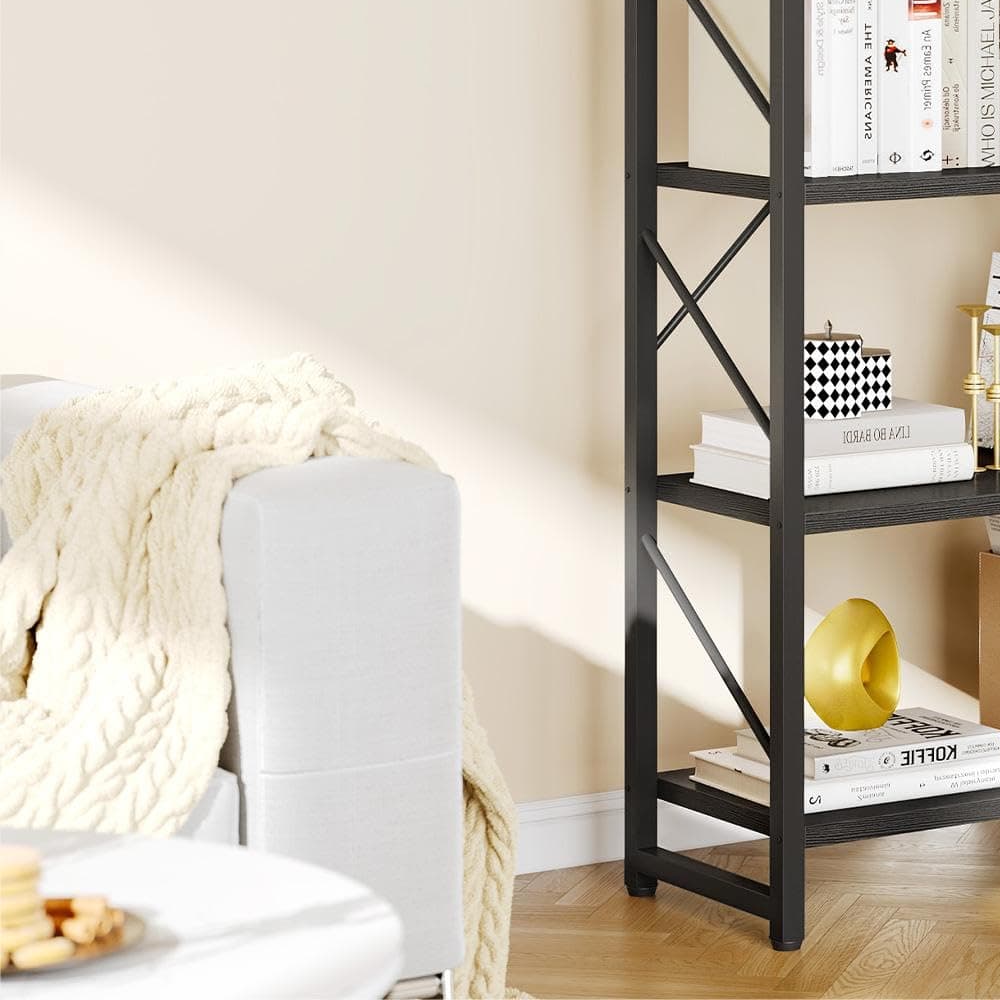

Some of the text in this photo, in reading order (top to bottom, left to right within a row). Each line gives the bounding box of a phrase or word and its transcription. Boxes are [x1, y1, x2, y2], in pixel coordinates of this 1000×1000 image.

[980, 23, 995, 100] MICHAEL
[980, 104, 995, 120] IS
[980, 124, 995, 167] WHO
